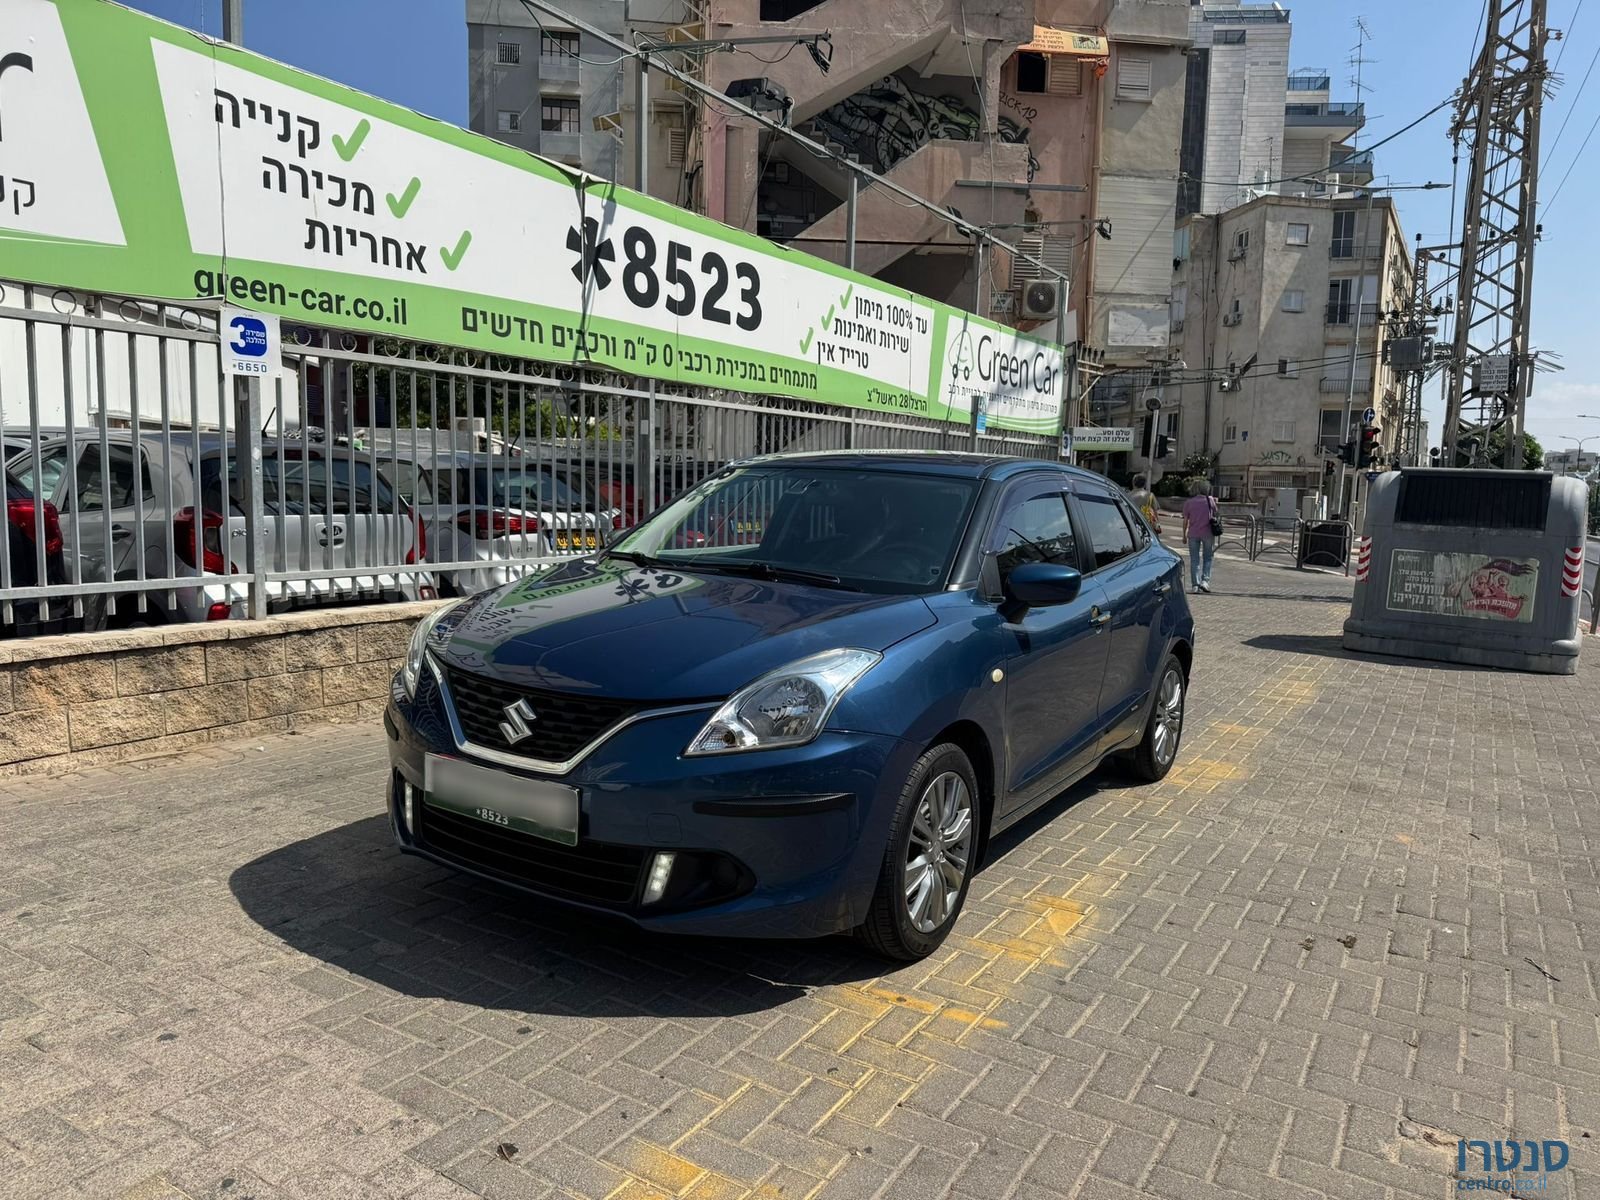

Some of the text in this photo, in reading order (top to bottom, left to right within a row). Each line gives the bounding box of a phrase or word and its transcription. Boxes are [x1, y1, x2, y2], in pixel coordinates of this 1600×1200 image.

[214, 88, 320, 158] קנייה
[262, 156, 375, 216] מכירה
[304, 218, 427, 274] אחריות
[194, 269, 407, 325] green-car.co.il
[855, 296, 927, 334] עד 100% מימון
[462, 307, 544, 344] חדשים
[552, 324, 616, 357] ורכבים
[834, 317, 909, 353] שירות ואמינות
[678, 350, 711, 374] רכבי
[716, 357, 765, 382] במכירת
[817, 341, 869, 369] טרייד אין
[978, 335, 1059, 396] Green Car
[770, 366, 817, 390] מתמחים
[899, 393, 909, 408] 28
